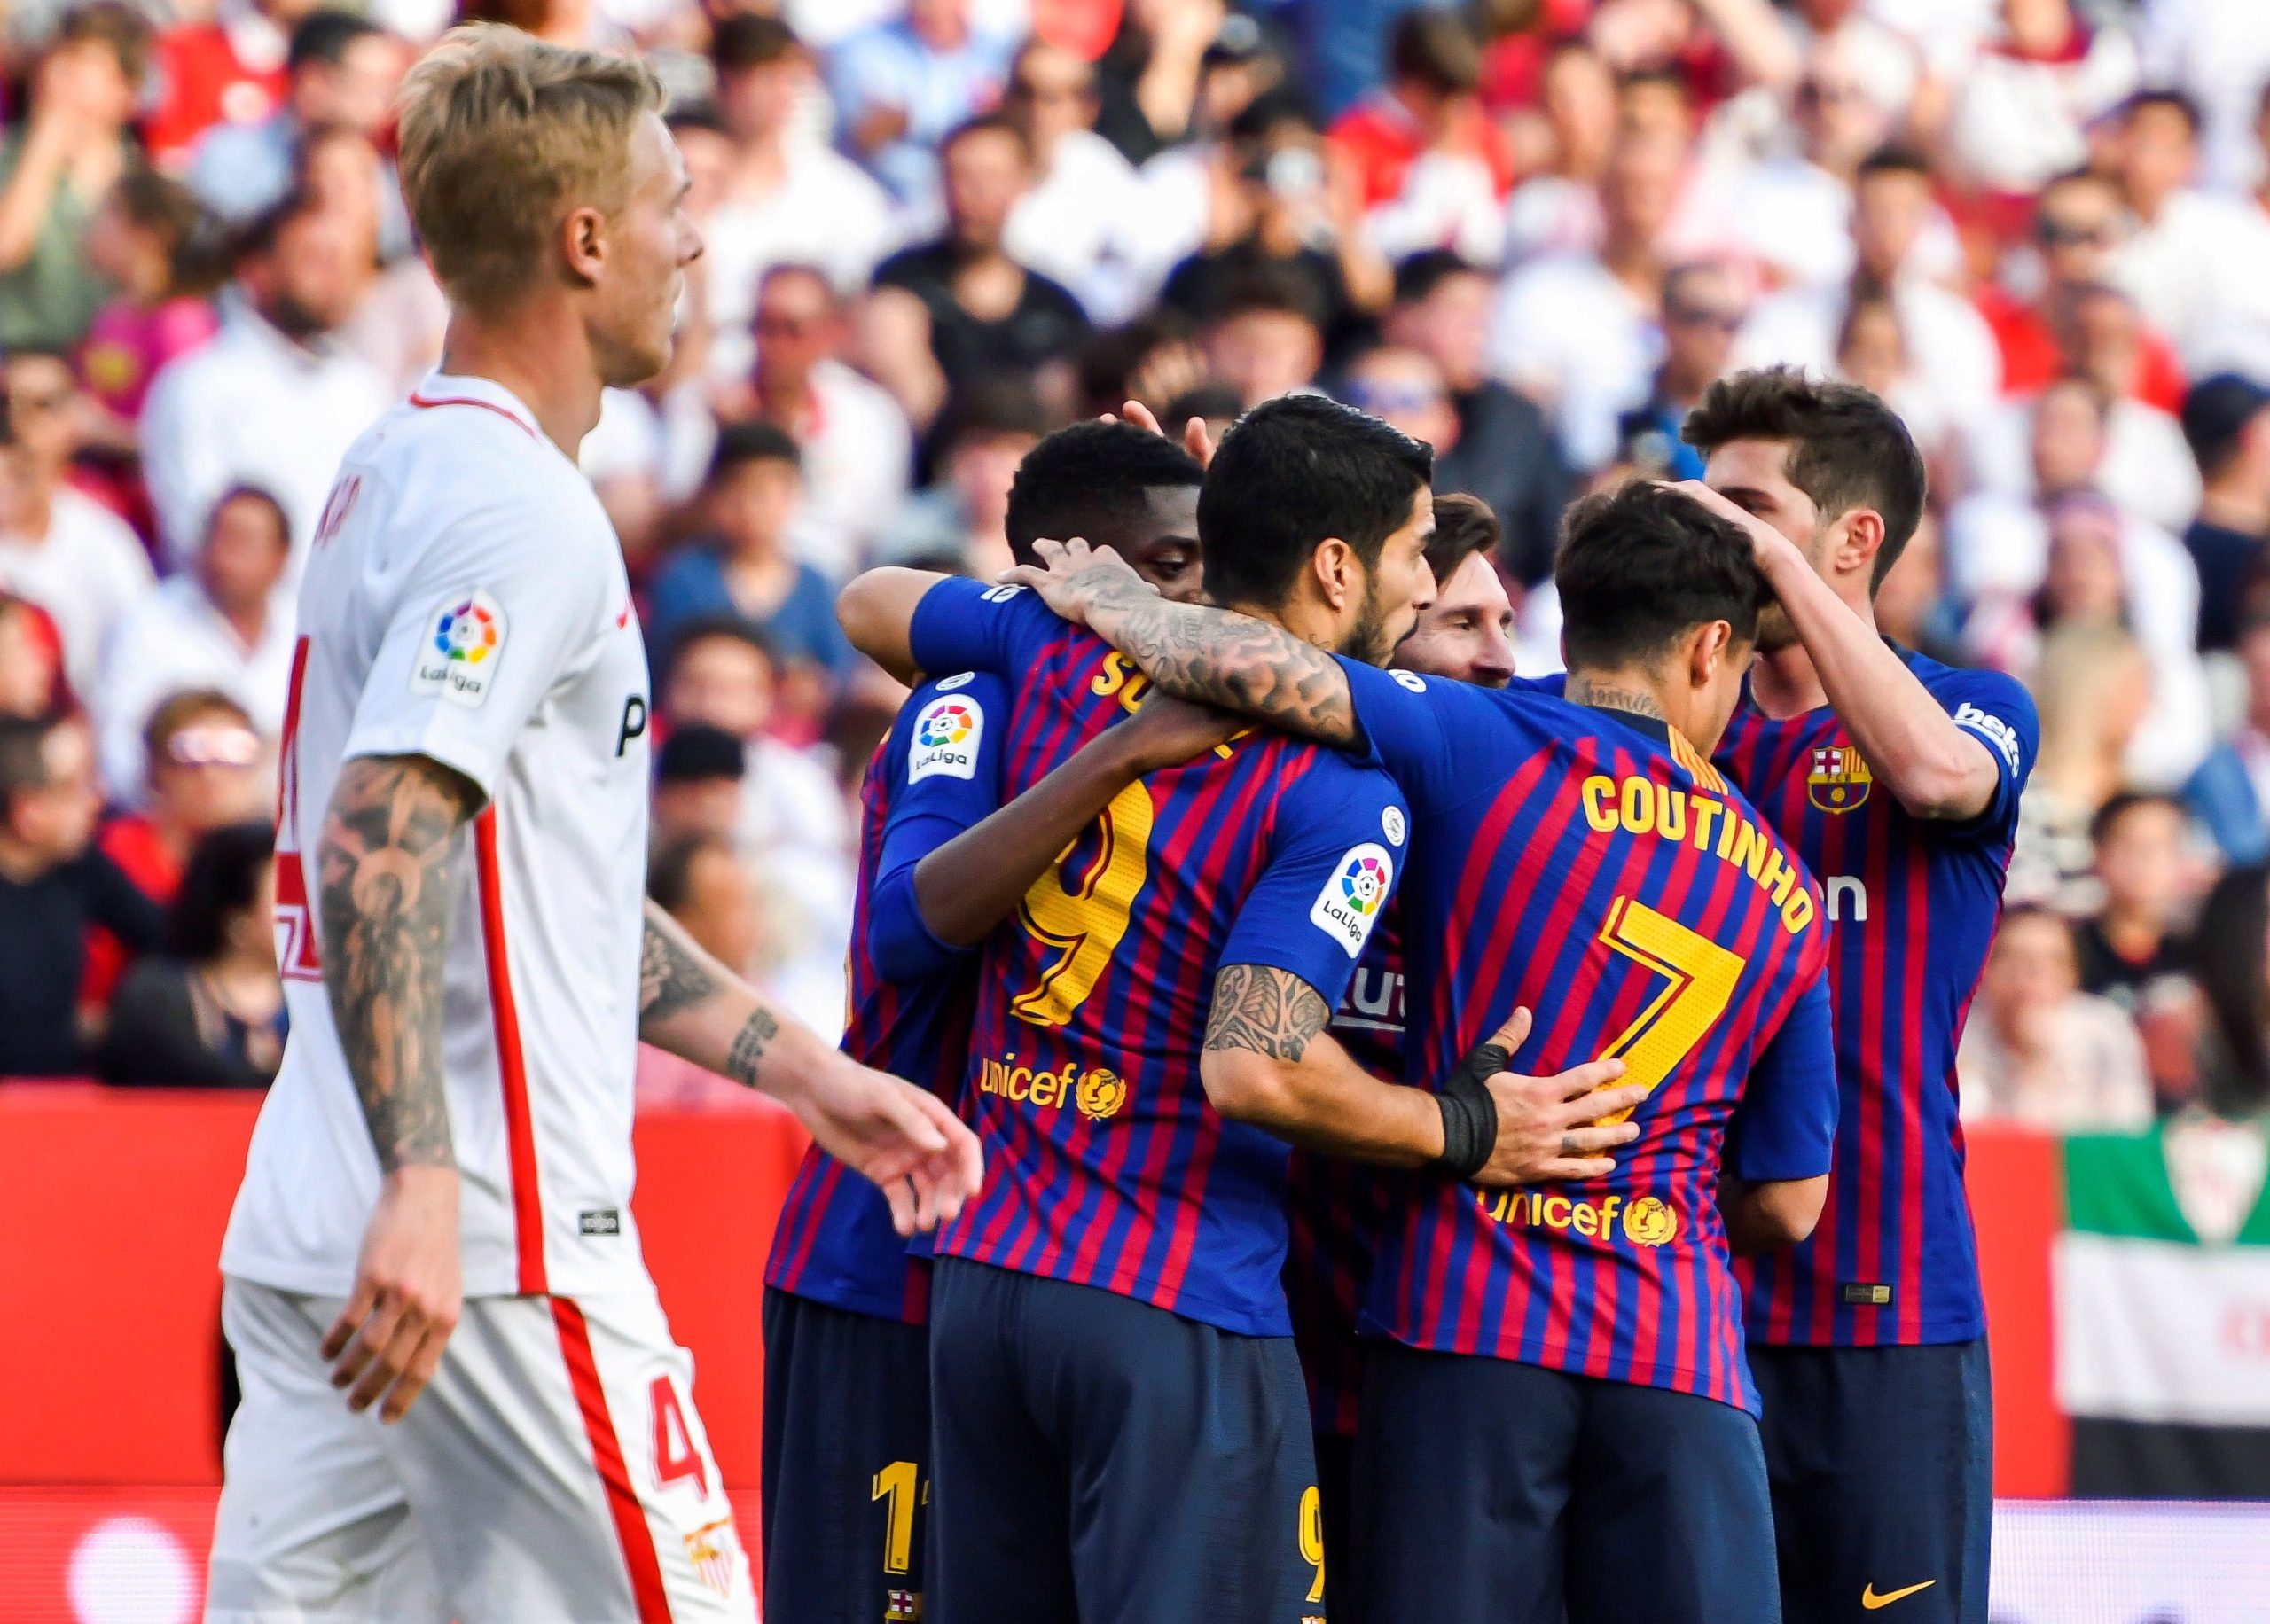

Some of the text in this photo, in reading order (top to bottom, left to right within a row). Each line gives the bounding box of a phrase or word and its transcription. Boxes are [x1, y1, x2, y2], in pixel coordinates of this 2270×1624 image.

[1954, 702, 2019, 779] beko
[1010, 778, 1154, 1027] 9
[1582, 775, 1814, 934] COUTINHO
[1323, 900, 1362, 942] LaLiga
[1593, 894, 1746, 1144] 7
[980, 1052, 1077, 1109] unicef
[649, 1375, 709, 1502] 4
[872, 1461, 929, 1575] 1
[1298, 1486, 1326, 1603] 9
